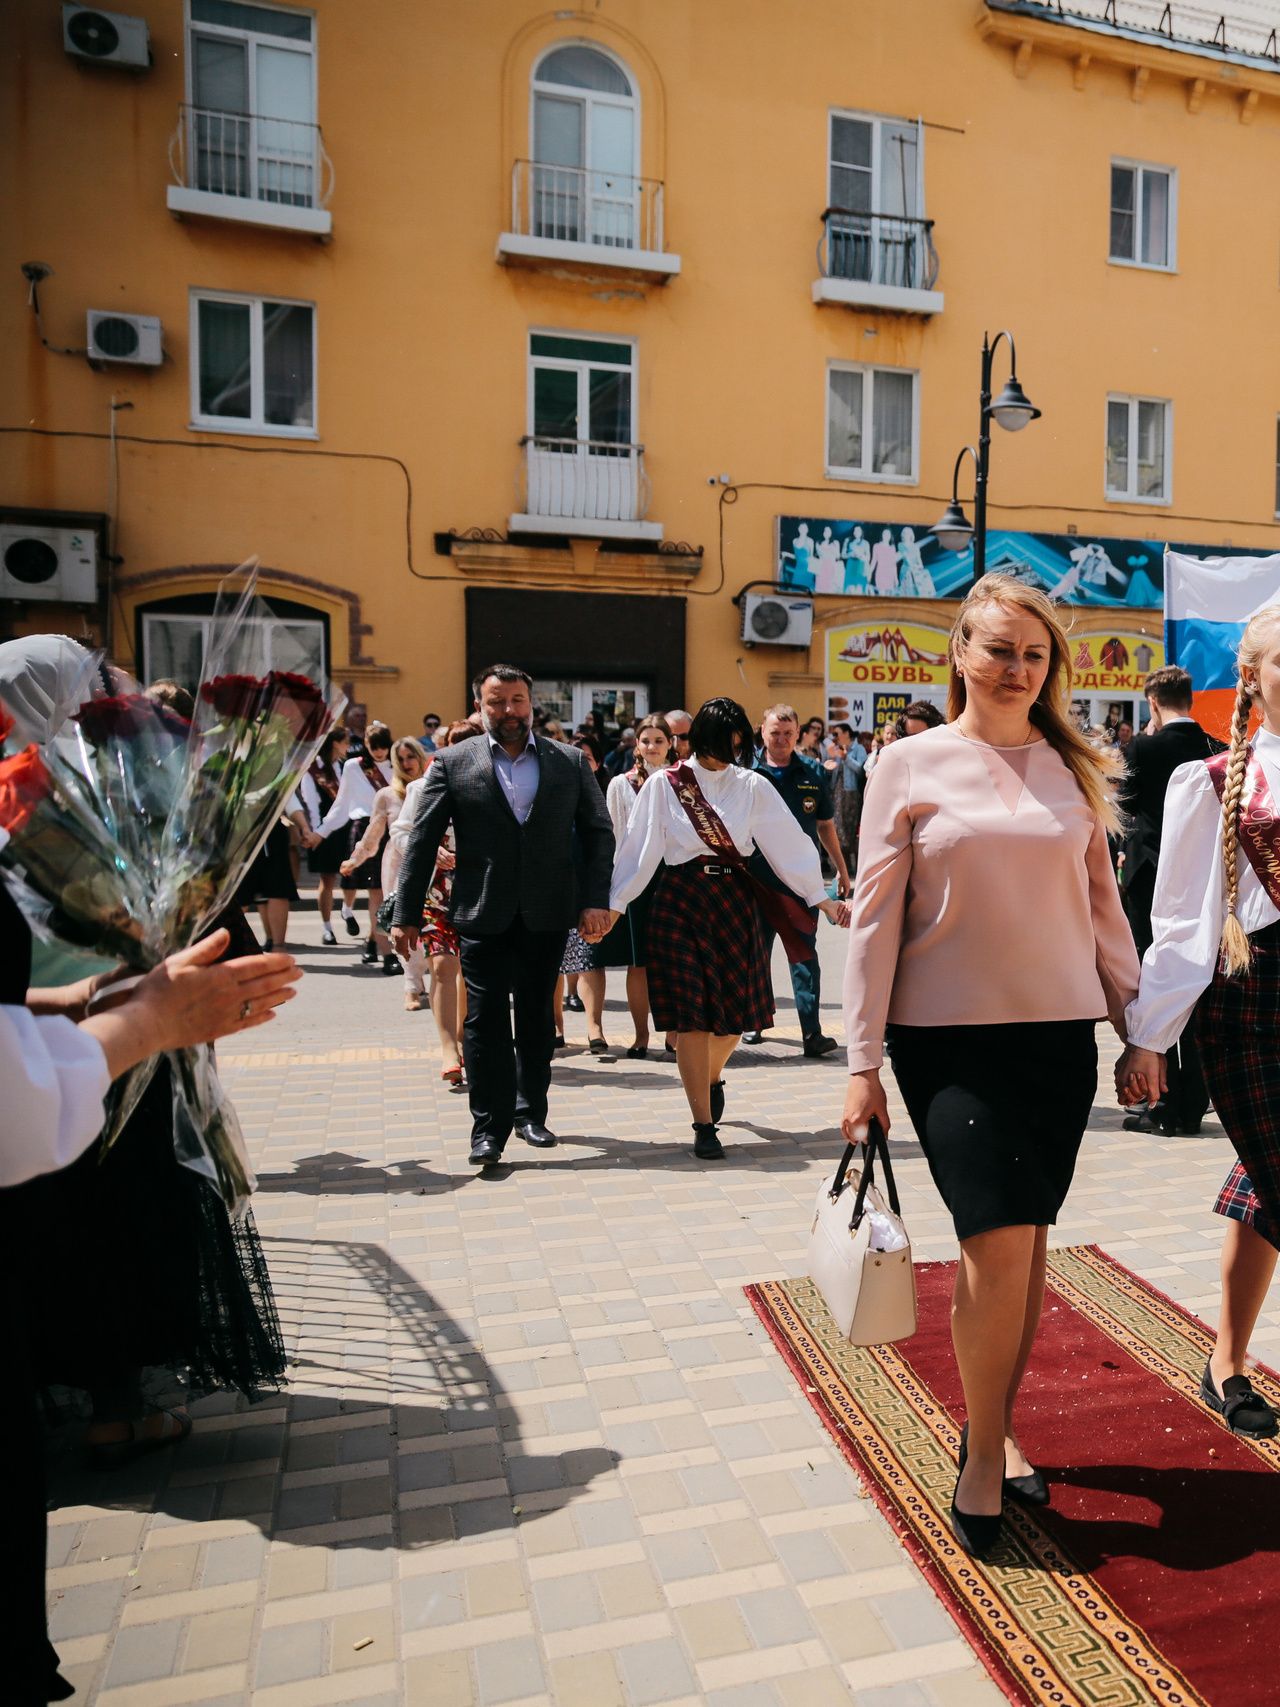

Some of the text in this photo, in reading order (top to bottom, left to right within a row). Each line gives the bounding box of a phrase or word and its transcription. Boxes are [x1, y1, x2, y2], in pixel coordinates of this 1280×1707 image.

[853, 664, 933, 683] ОБУВЬ
[1072, 672, 1146, 690] ОДЕЖД
[876, 696, 905, 710] ДЛЯ
